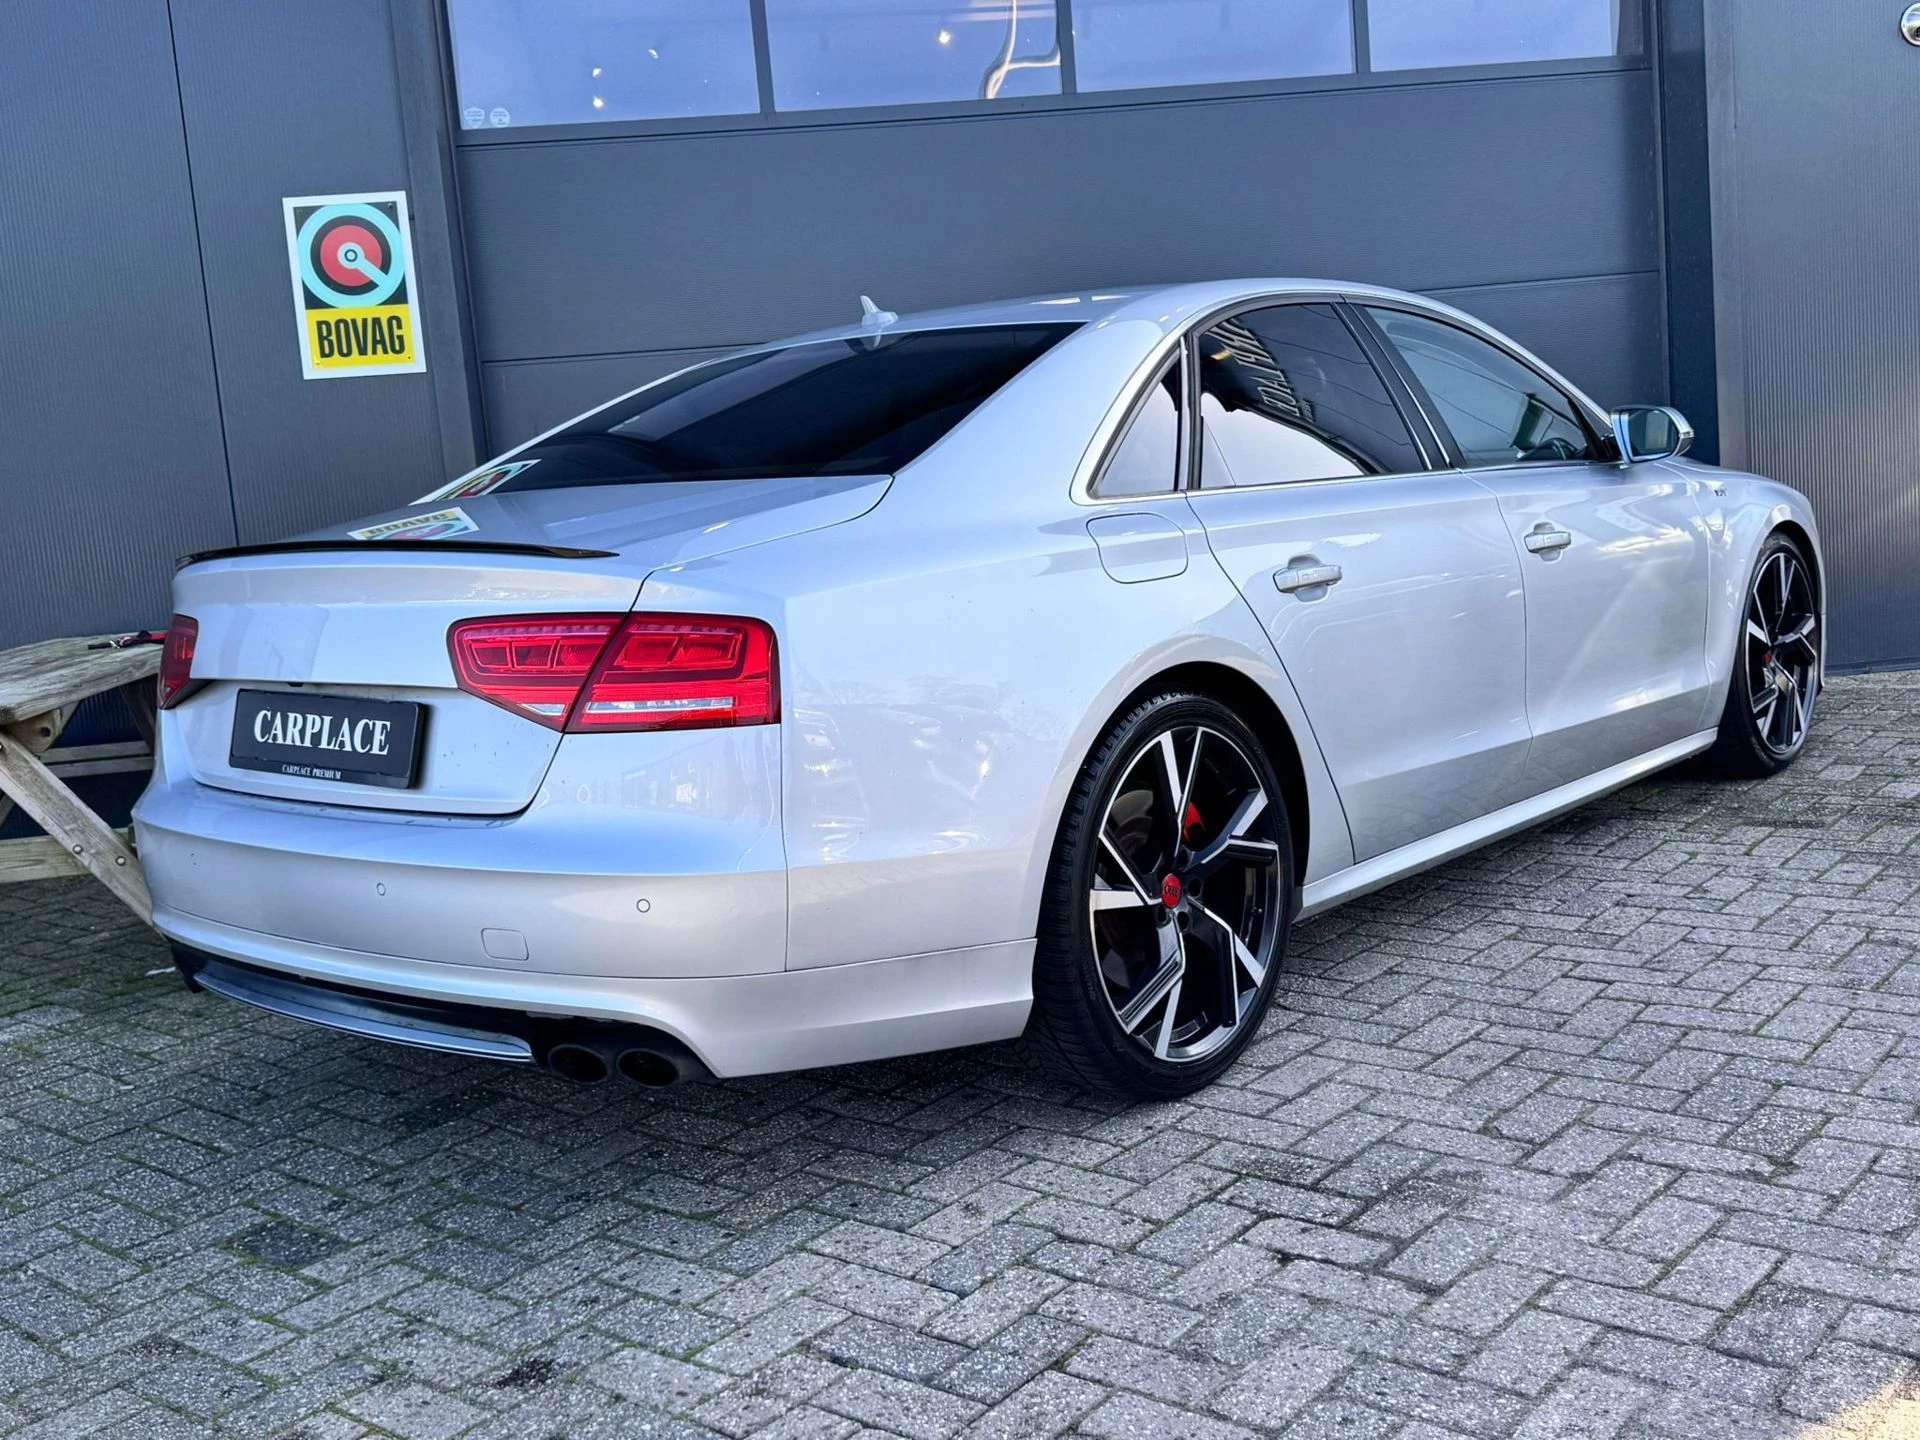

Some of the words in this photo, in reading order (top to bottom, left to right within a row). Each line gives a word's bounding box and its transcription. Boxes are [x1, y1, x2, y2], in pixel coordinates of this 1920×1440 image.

[316, 315, 405, 358] BOVAG
[254, 710, 391, 756] CARPLACE
[282, 764, 311, 776] CARPLACE
[312, 768, 342, 780] PREMIUM
